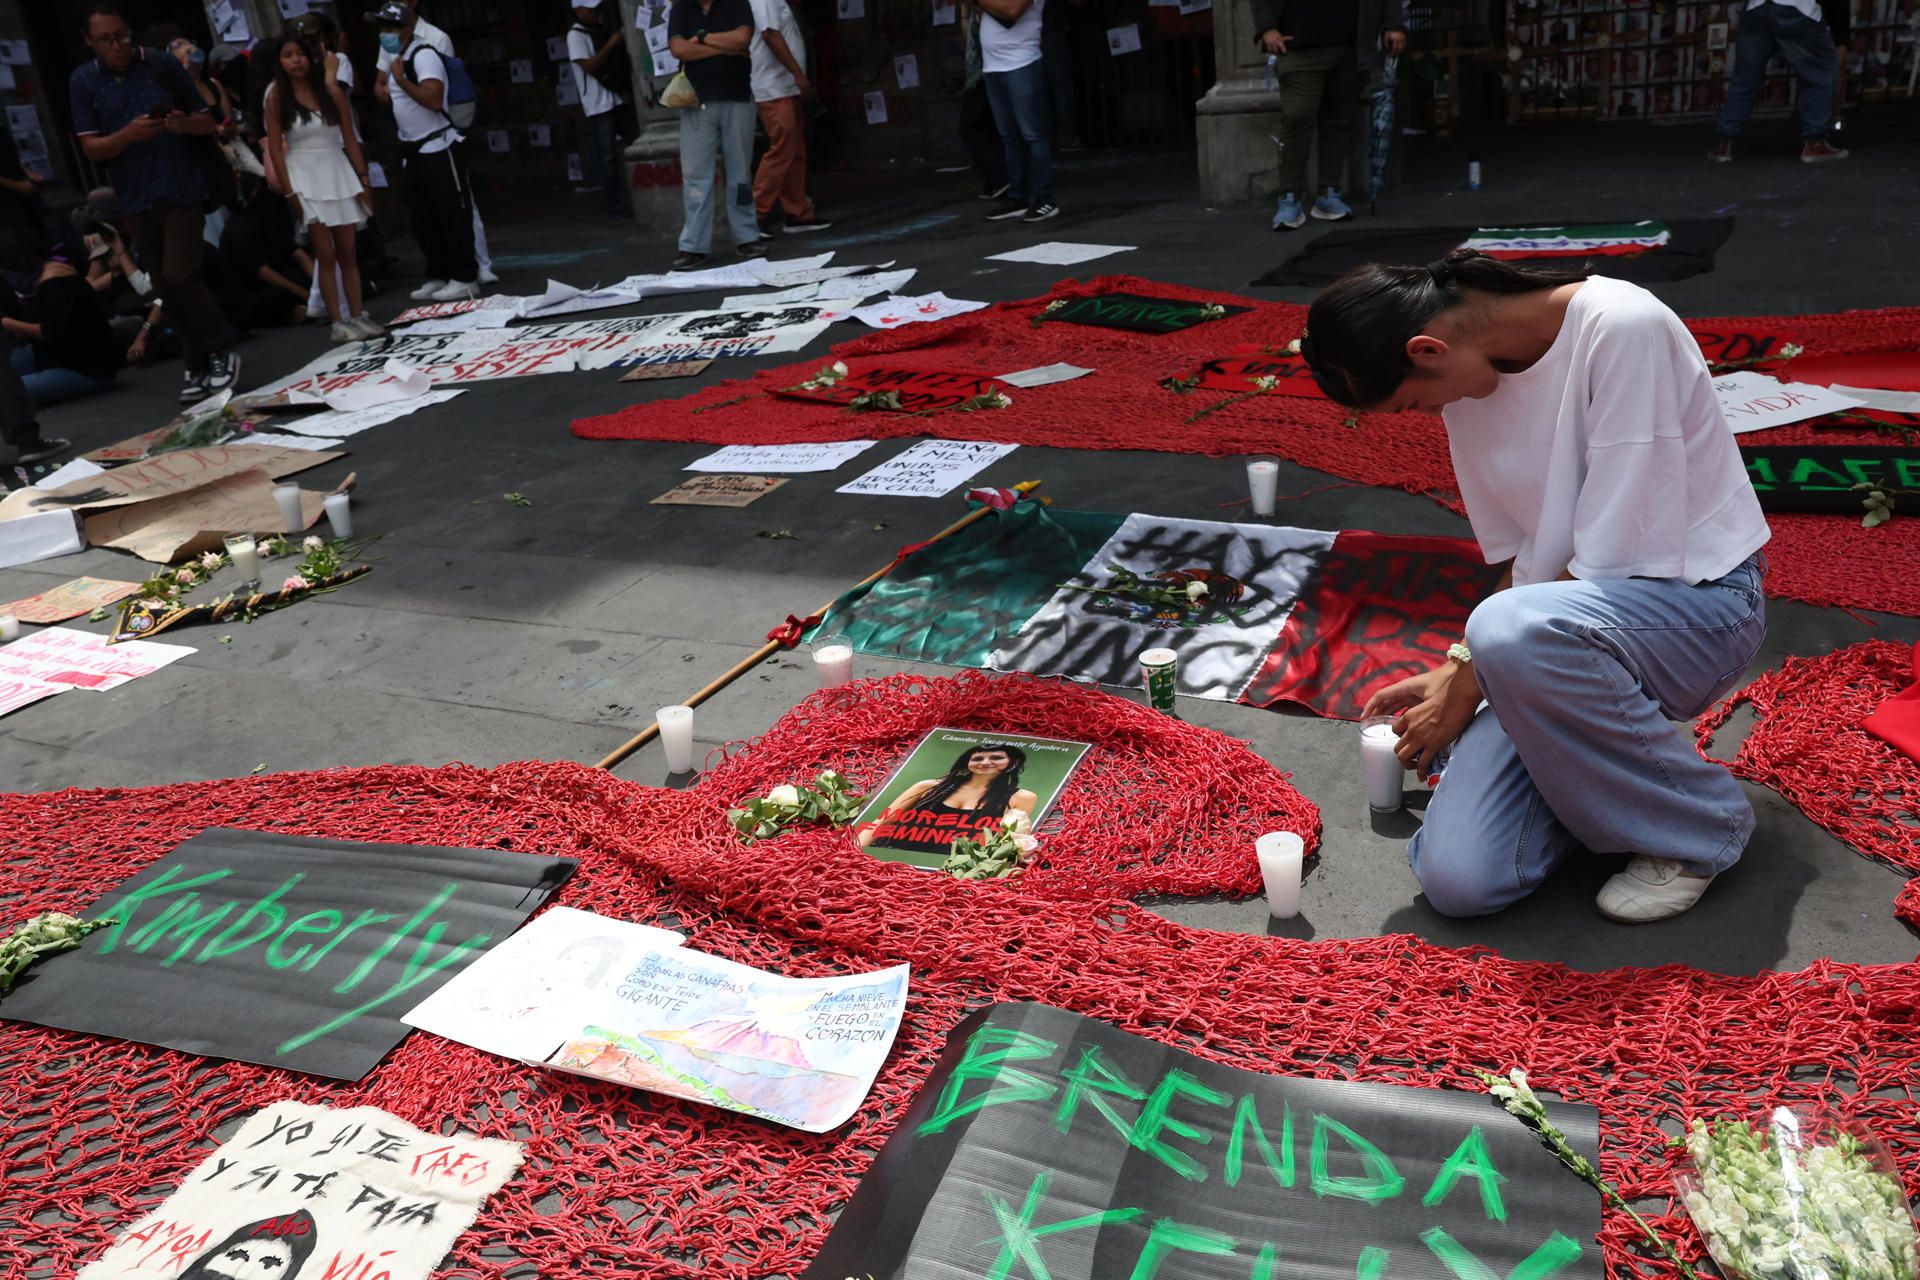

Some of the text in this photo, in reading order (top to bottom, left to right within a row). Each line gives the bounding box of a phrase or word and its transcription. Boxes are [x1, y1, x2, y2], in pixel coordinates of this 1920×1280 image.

[1729, 391, 1818, 415] VIDA
[884, 461, 960, 471] UNIDOS
[863, 475, 936, 485] JUSTICIA
[896, 470, 936, 478] POR
[886, 484, 948, 494] CLAUDIA
[942, 734, 977, 743] Claudia
[97, 863, 492, 1056] Kimberly
[652, 983, 672, 993] ESE
[687, 972, 745, 993] CANARIAS
[616, 984, 689, 1012] GIGANTE
[859, 992, 885, 1002] NIEVE
[838, 999, 900, 1012] SEMBLANTE
[813, 1012, 869, 1026] FUEGO
[914, 1020, 1508, 1224] BRENDA
[249, 1113, 314, 1150] YO
[311, 1122, 365, 1157] SI
[357, 1128, 408, 1164] TE
[202, 1157, 441, 1233] Y SI TE PASA
